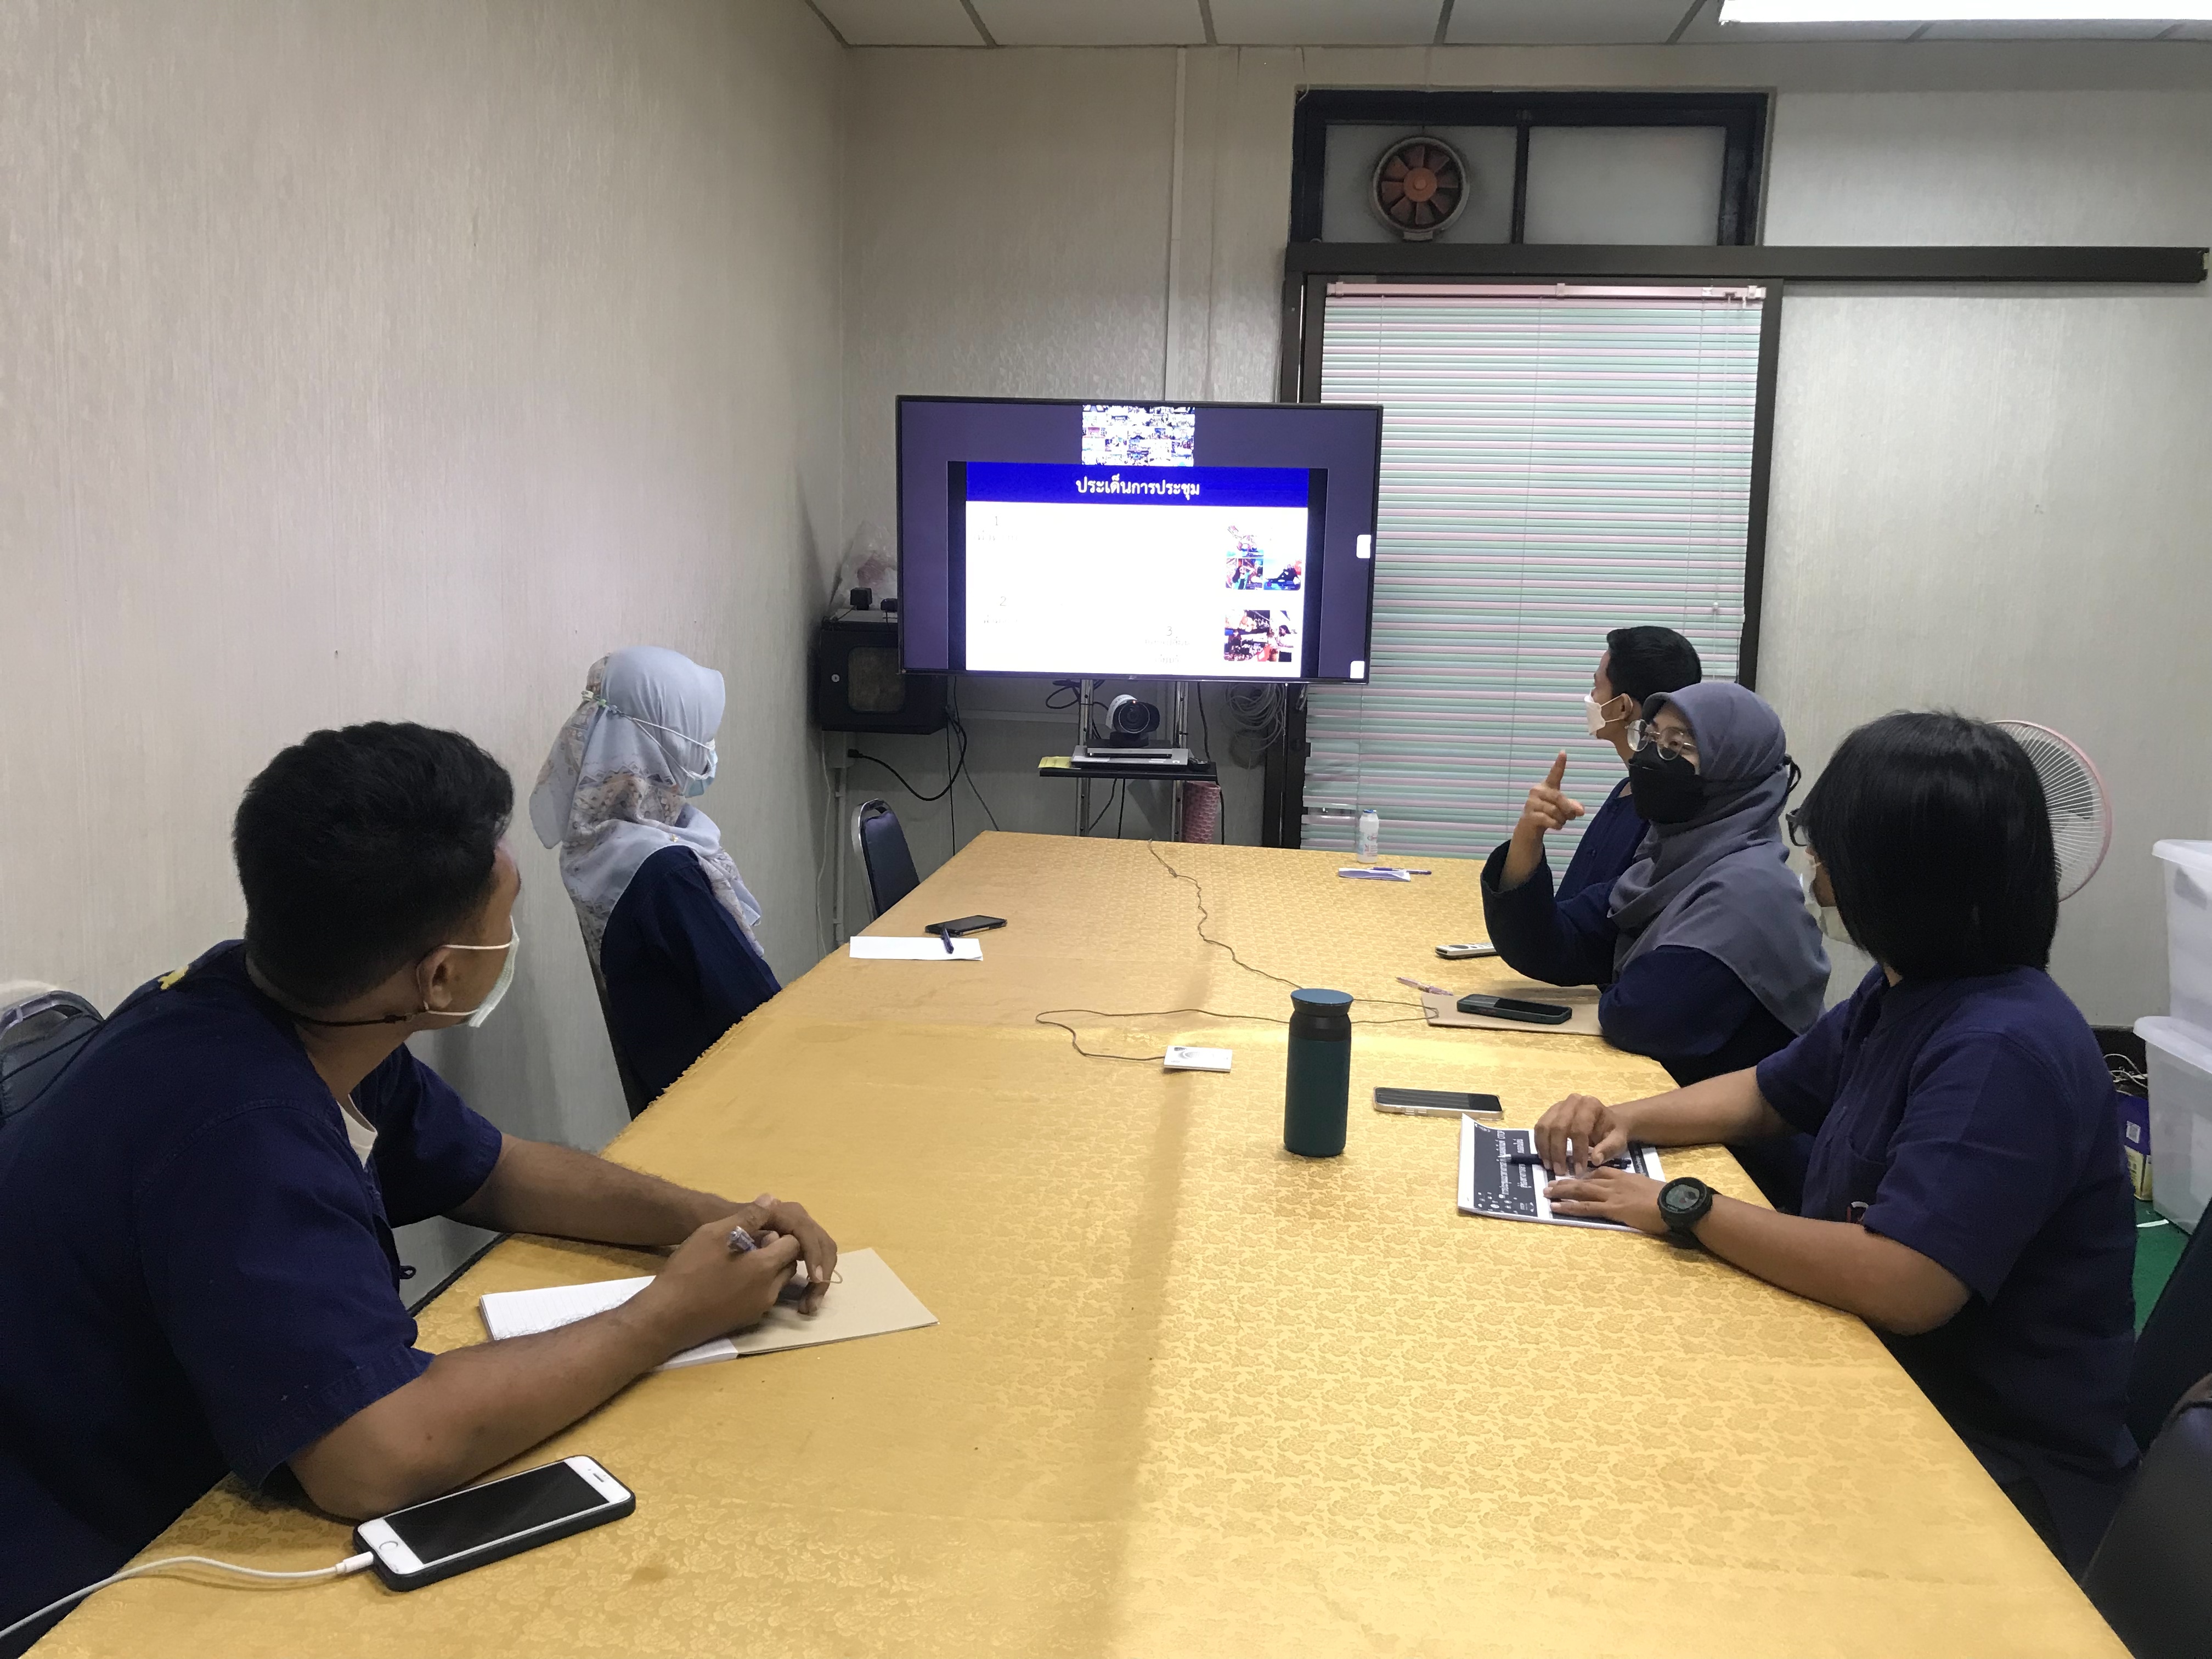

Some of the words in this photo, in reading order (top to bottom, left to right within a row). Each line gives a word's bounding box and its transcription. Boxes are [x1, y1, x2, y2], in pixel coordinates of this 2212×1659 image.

[1075, 473, 1200, 500] ประเด็นการประชุม
[994, 515, 999, 526] 1
[999, 595, 1007, 607] 2
[1165, 625, 1173, 636] 3
